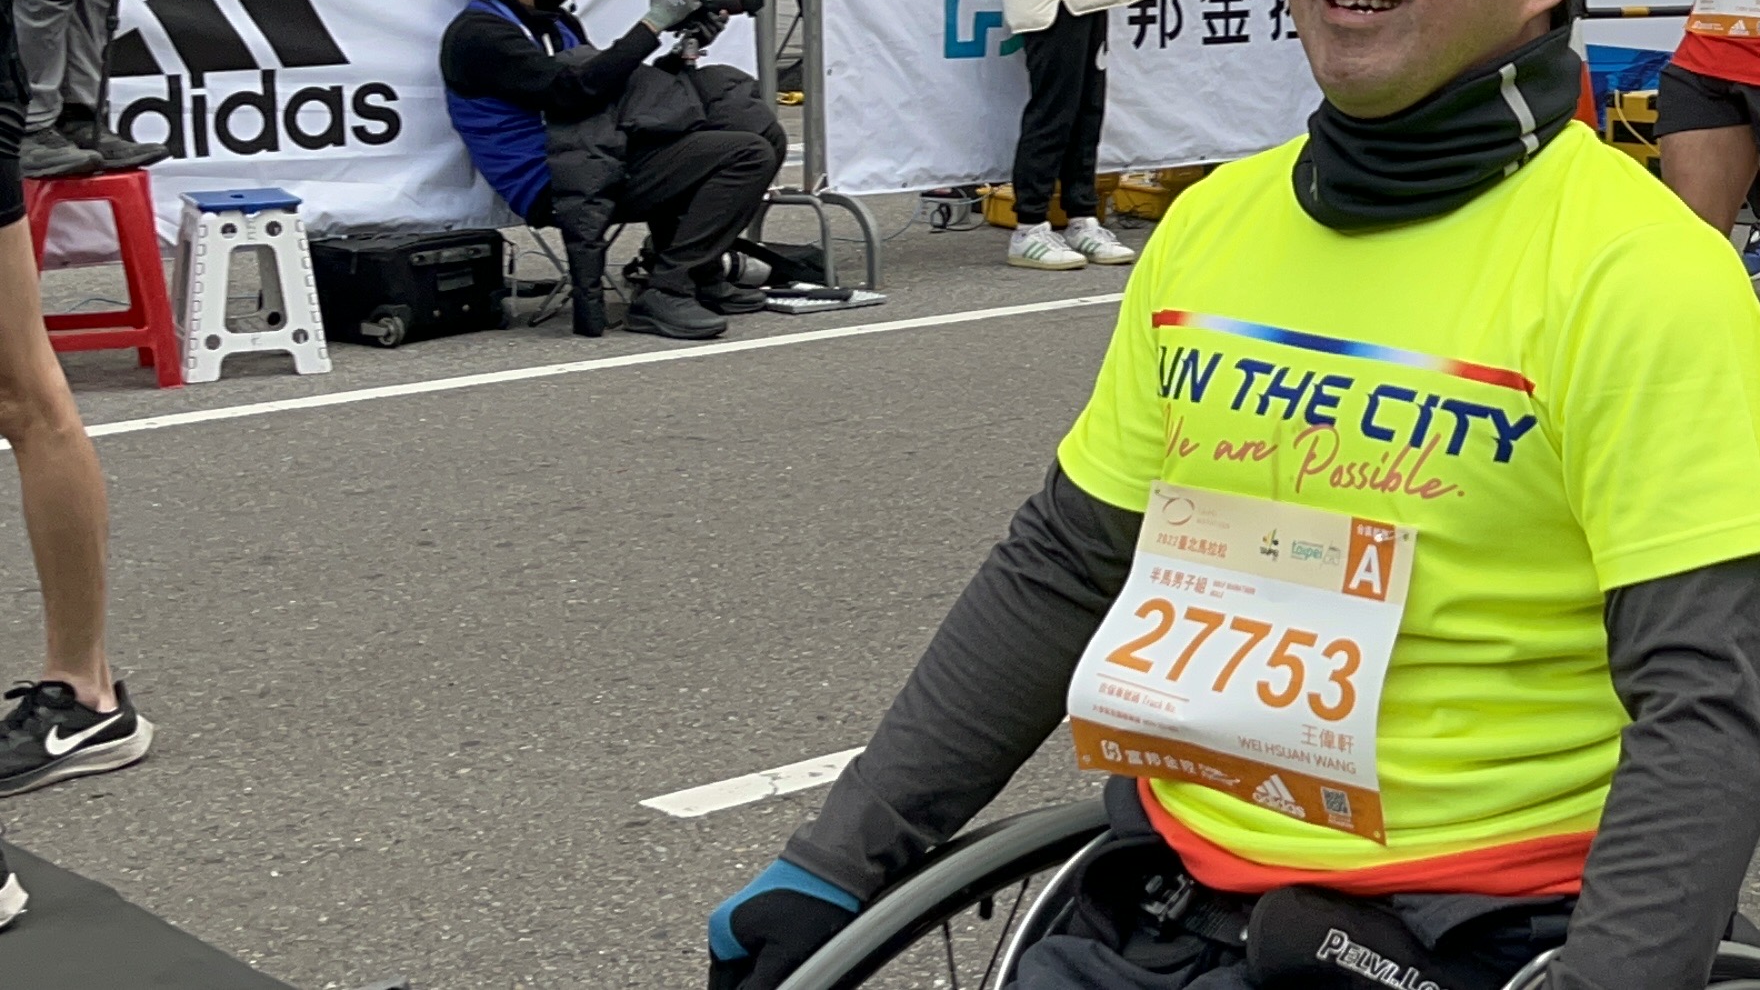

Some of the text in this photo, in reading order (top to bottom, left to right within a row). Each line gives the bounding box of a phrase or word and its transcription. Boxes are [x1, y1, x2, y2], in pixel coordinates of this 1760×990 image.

[115, 68, 402, 160] didas
[1234, 357, 1355, 427] THE
[1360, 384, 1538, 465] CITY
[1213, 435, 1279, 462] are
[1293, 423, 1466, 500] Possible.
[1349, 544, 1382, 595] A
[1104, 598, 1363, 721] 27753
[1237, 735, 1357, 776] WEI HSUAN WANG
